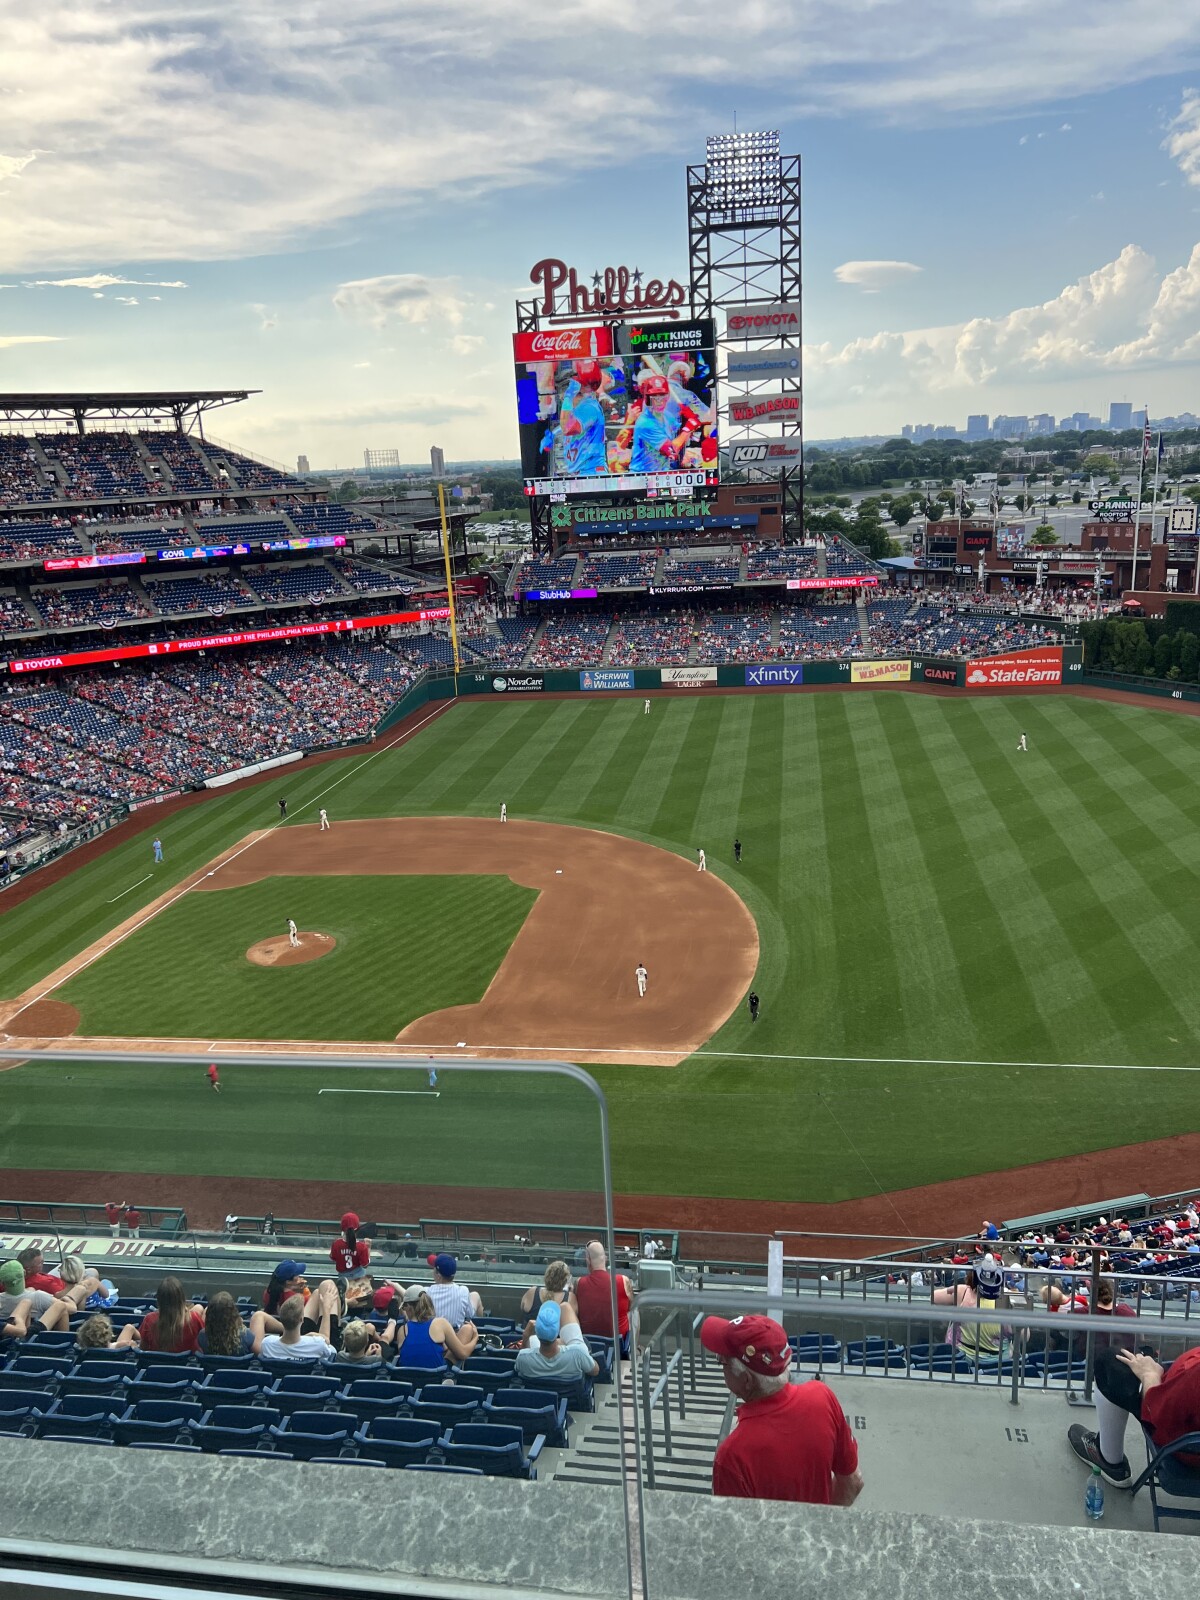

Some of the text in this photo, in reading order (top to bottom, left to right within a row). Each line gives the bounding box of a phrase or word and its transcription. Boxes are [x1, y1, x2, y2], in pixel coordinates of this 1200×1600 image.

[530, 258, 686, 316] Phillies
[745, 313, 798, 328] TOYOTA
[532, 331, 582, 351] Coca-Cola
[631, 330, 703, 345] DRAFTKINGS
[648, 340, 702, 350] SPORTSBOOK
[733, 446, 768, 461] KDI
[675, 475, 682, 486] 0
[686, 474, 693, 485] 0
[696, 474, 703, 484] 0
[1091, 501, 1137, 509] CP RANKIN
[574, 501, 711, 523] Citizens Bank Park
[965, 537, 990, 545] GIANT
[162, 550, 185, 559] GOYA
[801, 578, 857, 588] RAV4th INNING
[539, 590, 571, 600] StubHub
[655, 585, 704, 594] KLYRRUM.COM
[178, 624, 329, 650] PROUD PARTNER OF THE PHILADELPHIA PHILLIES
[24, 658, 63, 670] TOYOTA
[839, 663, 850, 671] 374
[1069, 663, 1082, 671] 409
[594, 671, 630, 680] SHERWIN
[748, 667, 800, 685] xfinity
[858, 663, 909, 680] W.B.MASON
[924, 668, 957, 680] GIANT
[507, 677, 544, 686] NovaCare
[1172, 690, 1183, 699] 401
[163, 790, 181, 800] TOYOTA
[136, 798, 156, 808] TOYOTA
[345, 1254, 353, 1269] 3
[1004, 1427, 1029, 1443] 15
